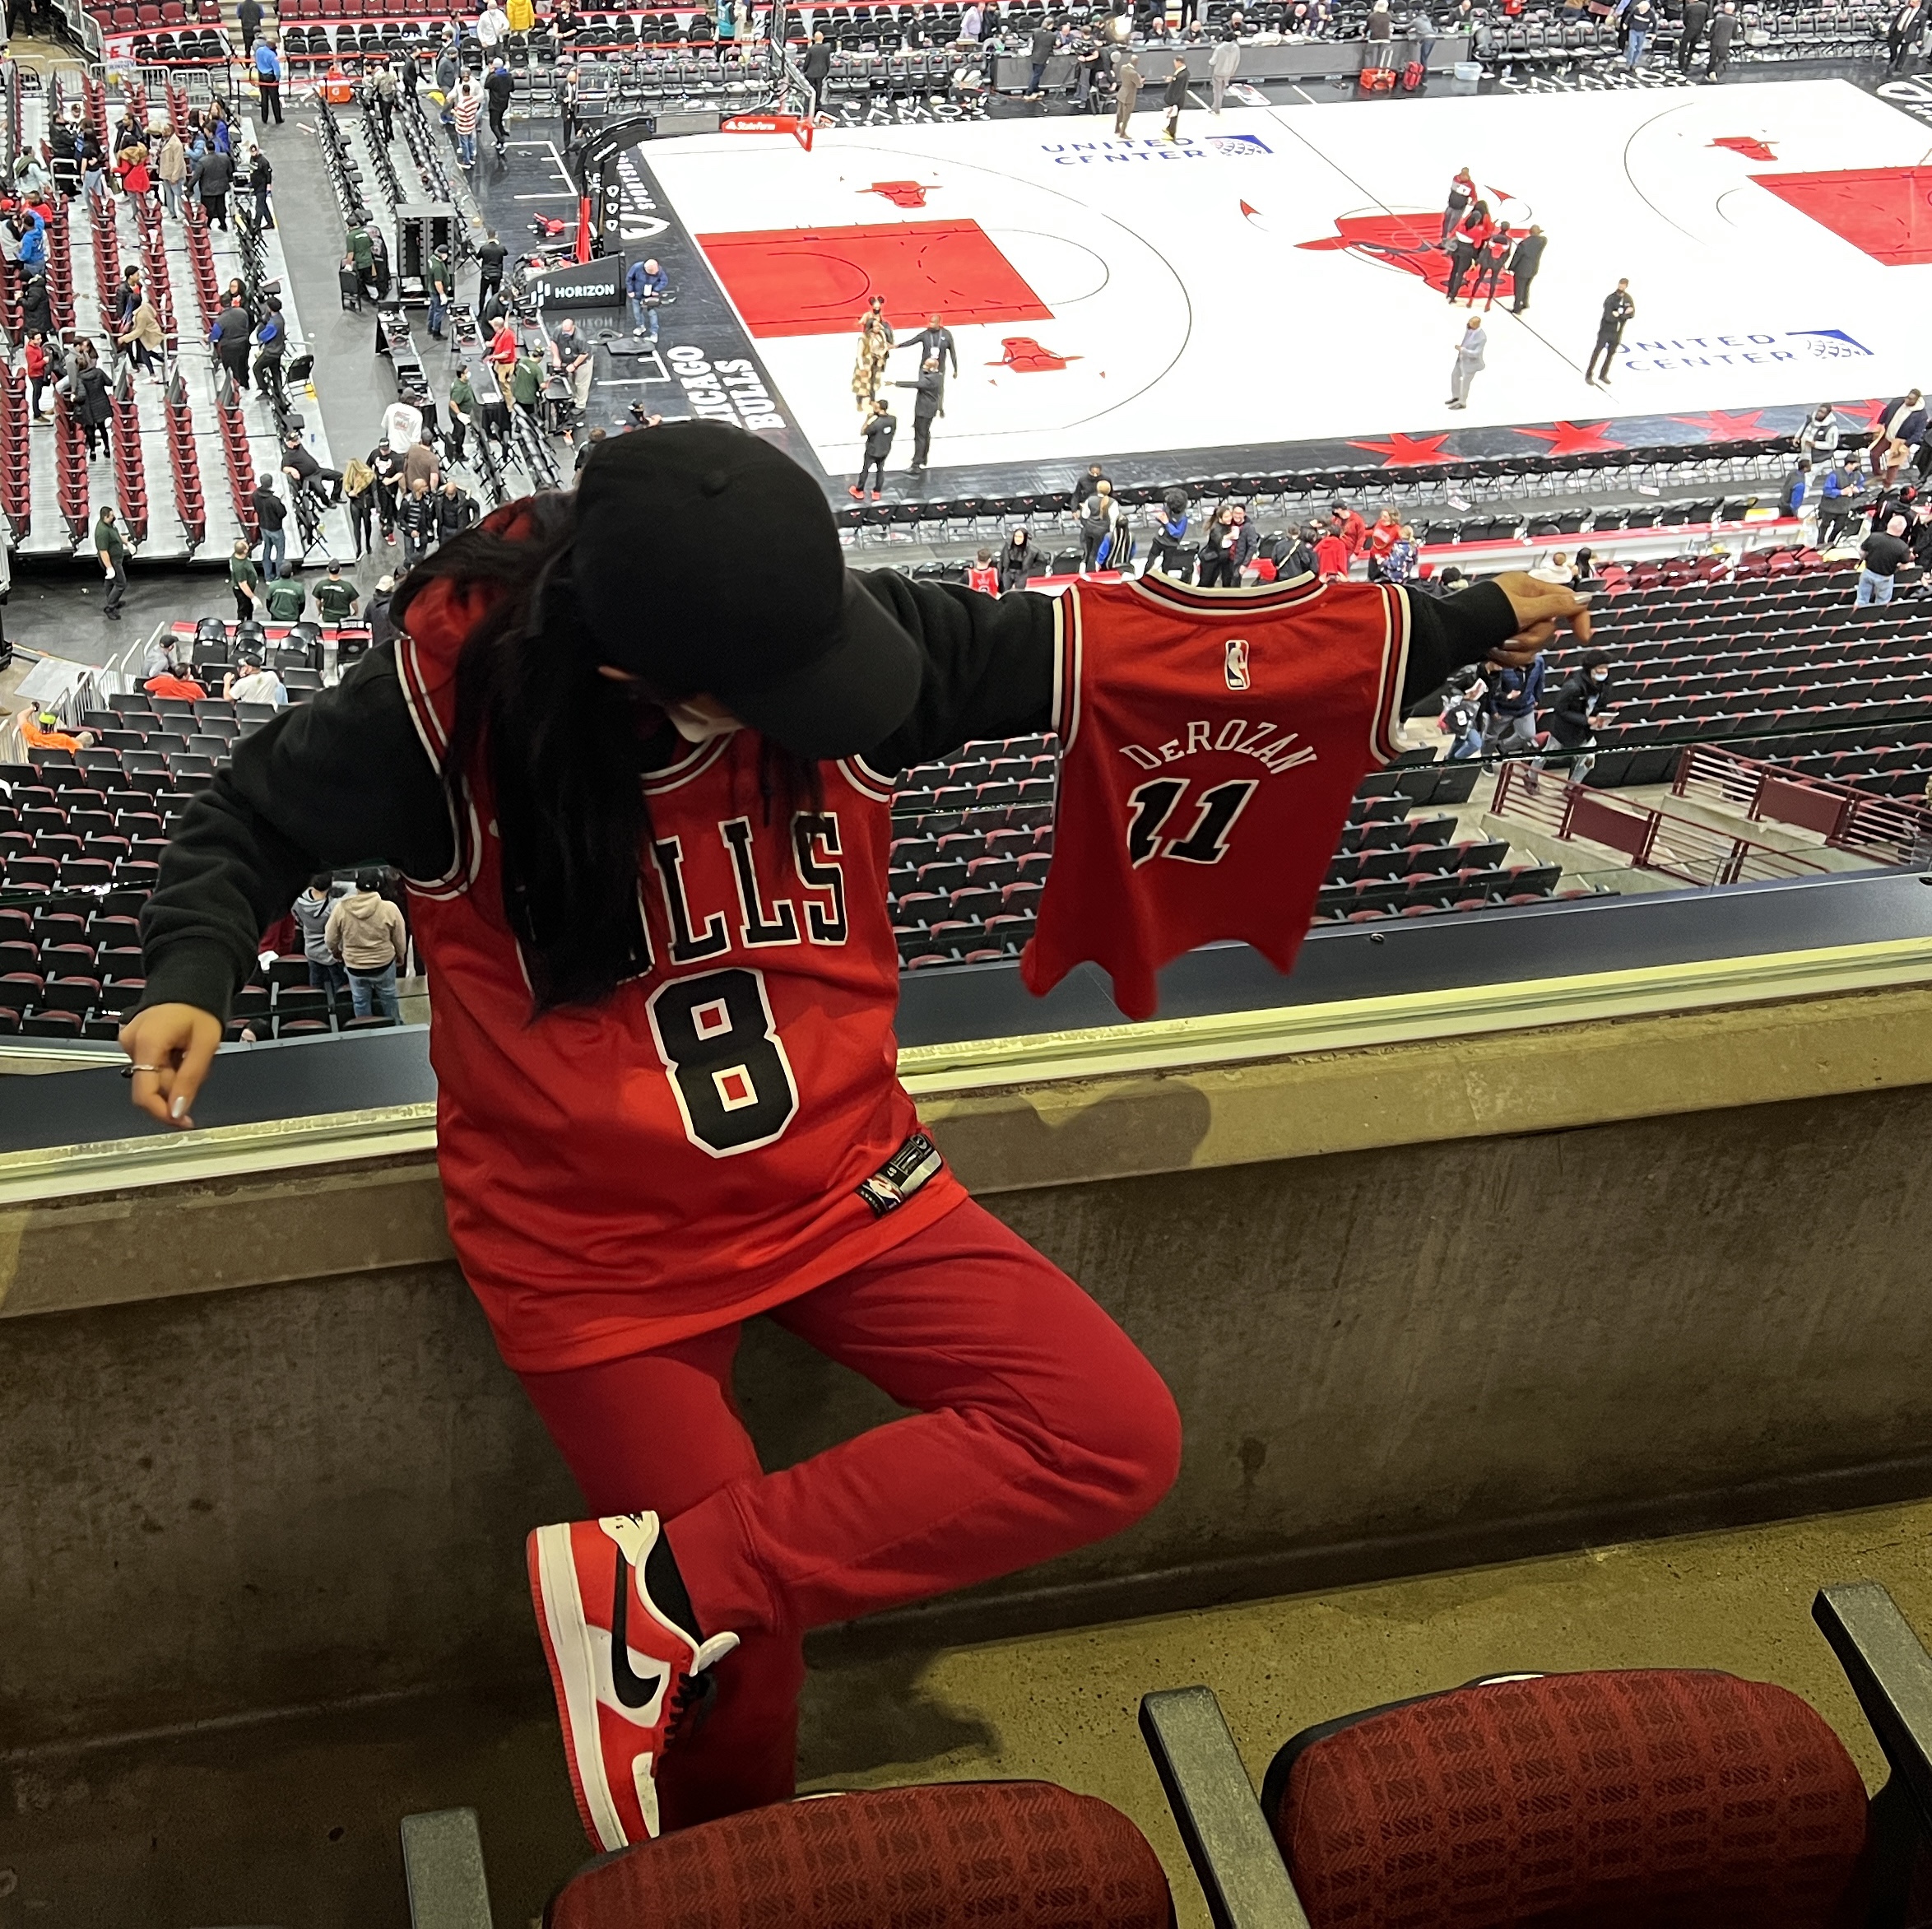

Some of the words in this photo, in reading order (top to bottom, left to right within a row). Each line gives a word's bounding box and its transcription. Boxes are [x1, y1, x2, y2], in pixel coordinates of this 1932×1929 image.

[1499, 67, 1688, 90] CALAMOS
[1041, 137, 1194, 152] UNITED
[1055, 150, 1207, 165] CENTER
[555, 284, 615, 299] HORIZON
[1626, 351, 1799, 371] CENTER
[704, 359, 787, 432] BULLS
[1126, 777, 1261, 871] 11
[634, 811, 849, 971] LLS
[644, 966, 800, 1160] 8
